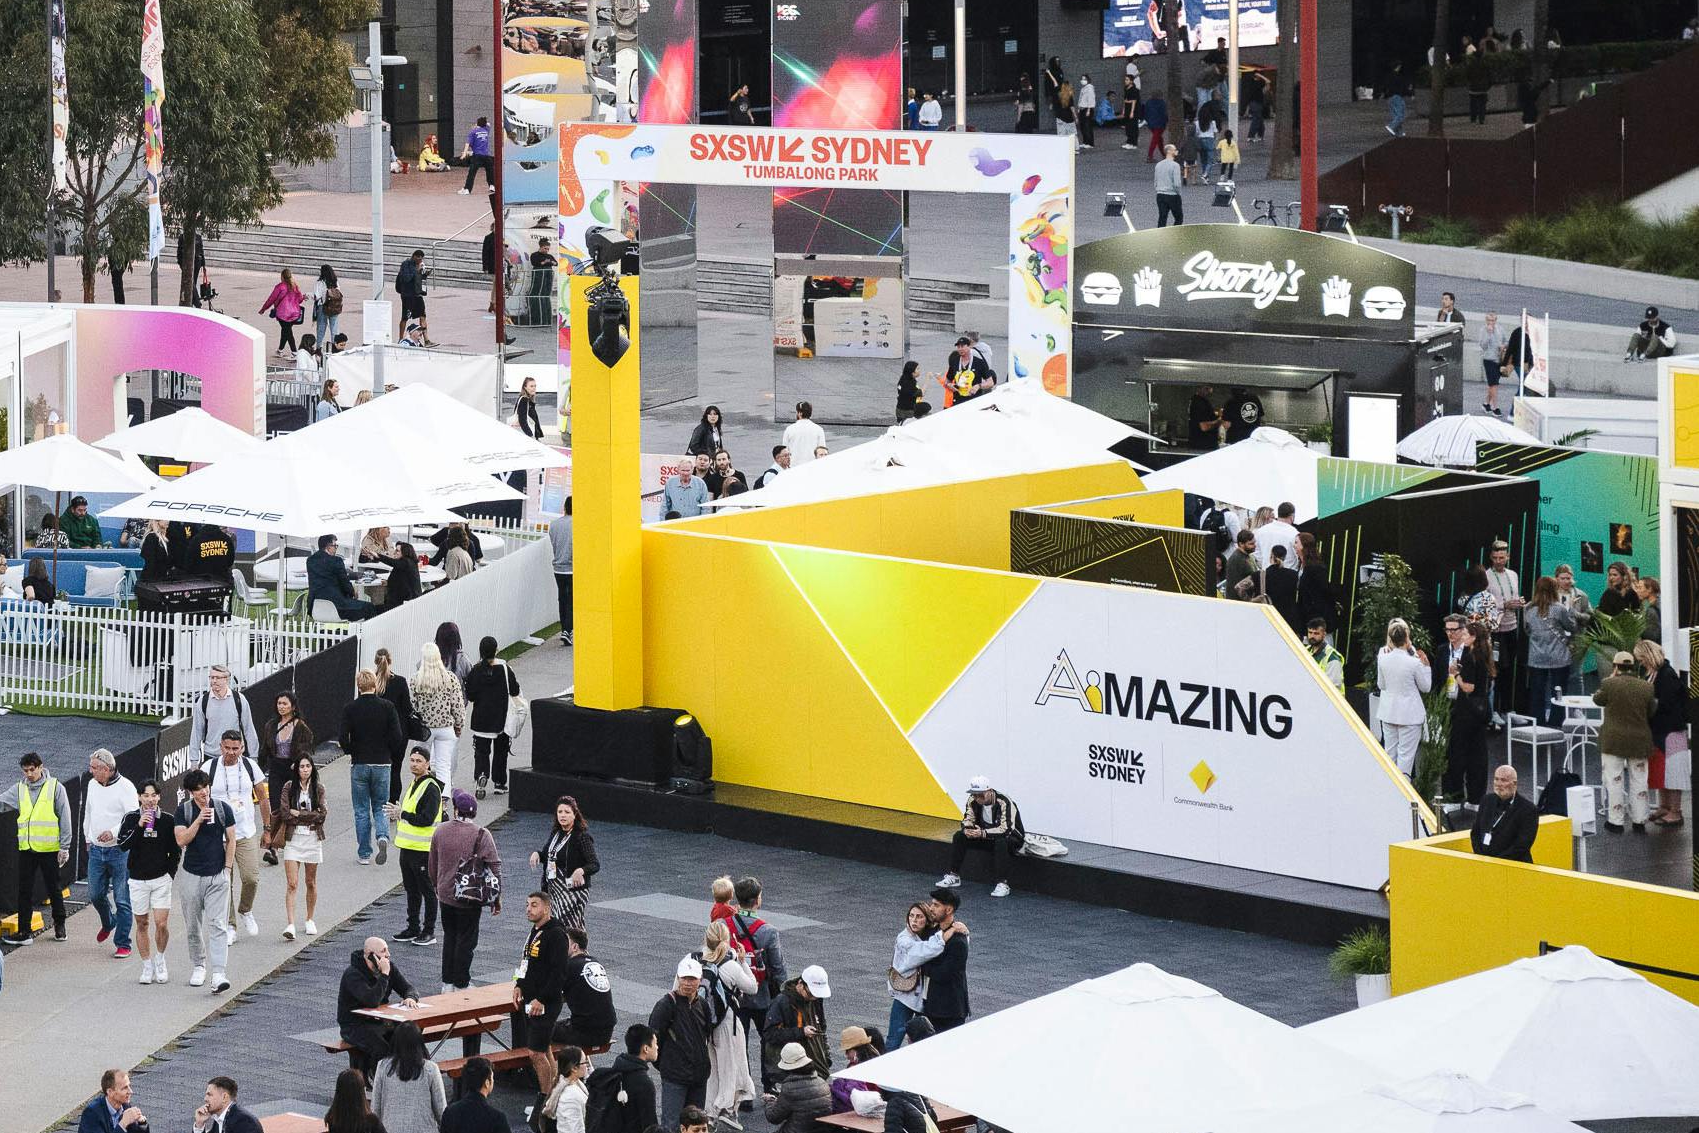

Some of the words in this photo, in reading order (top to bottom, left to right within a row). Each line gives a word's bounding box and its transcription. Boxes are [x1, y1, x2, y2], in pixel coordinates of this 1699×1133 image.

[689, 133, 775, 162] SXSW
[811, 136, 934, 166] SYDNEY
[743, 165, 835, 181] TUMBALONG
[838, 168, 879, 182] PARK
[1176, 249, 1306, 310] Shorty's
[660, 465, 679, 476] SXS
[146, 500, 285, 523] PORSCHE
[317, 504, 424, 524] PORSCHE
[200, 540, 220, 551] SXSW
[200, 548, 229, 558] SYDNEY
[162, 745, 187, 782] SXSW
[1088, 743, 1130, 766] SXSW
[1088, 761, 1146, 785] SYDNEY
[1173, 795, 1219, 811] Commonwealth
[1218, 802, 1234, 812] Bank
